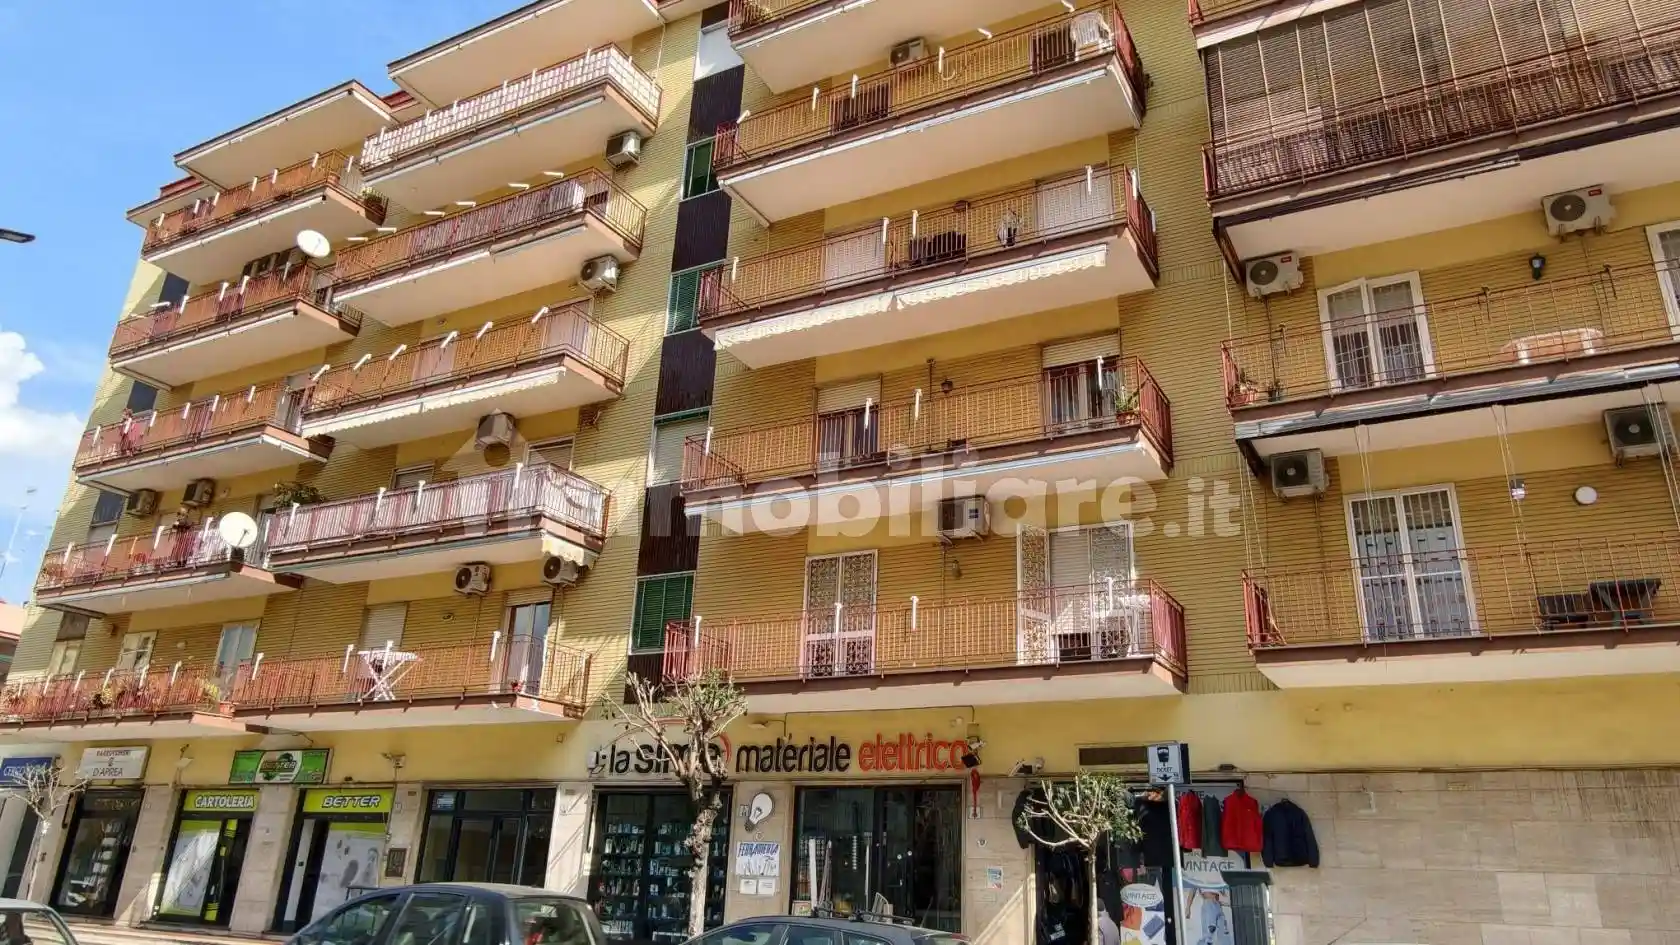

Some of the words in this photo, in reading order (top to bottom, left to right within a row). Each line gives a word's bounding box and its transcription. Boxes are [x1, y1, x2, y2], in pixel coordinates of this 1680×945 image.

[608, 744, 631, 774] la
[735, 735, 851, 773] materiale
[858, 731, 968, 773] elettrico
[195, 794, 255, 809] CARTOLERIA
[321, 794, 381, 809] BETTER
